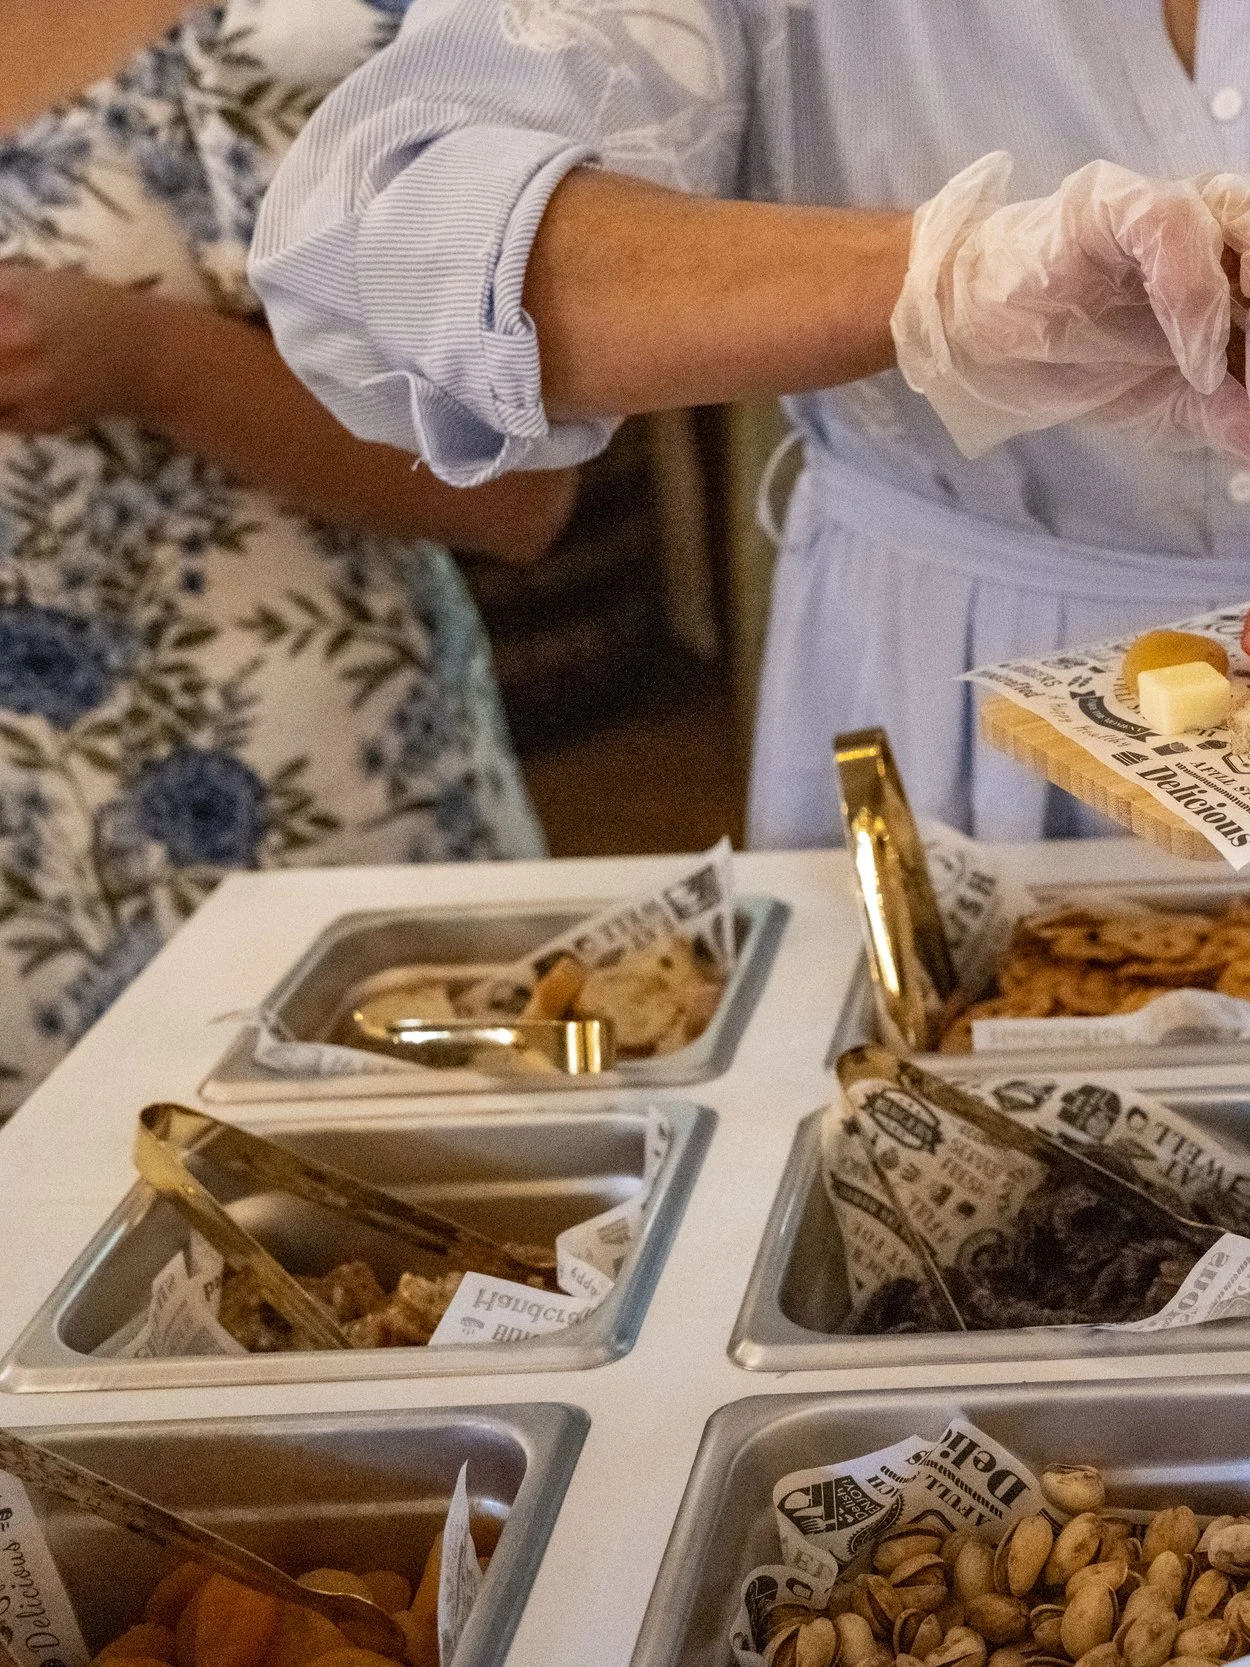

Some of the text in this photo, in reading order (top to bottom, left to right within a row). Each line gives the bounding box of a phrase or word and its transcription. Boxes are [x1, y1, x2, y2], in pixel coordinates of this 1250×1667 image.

[834, 1486, 868, 1523] Delish
[841, 1477, 882, 1516] ENJOY!
[3, 1539, 61, 1653] Delicious
